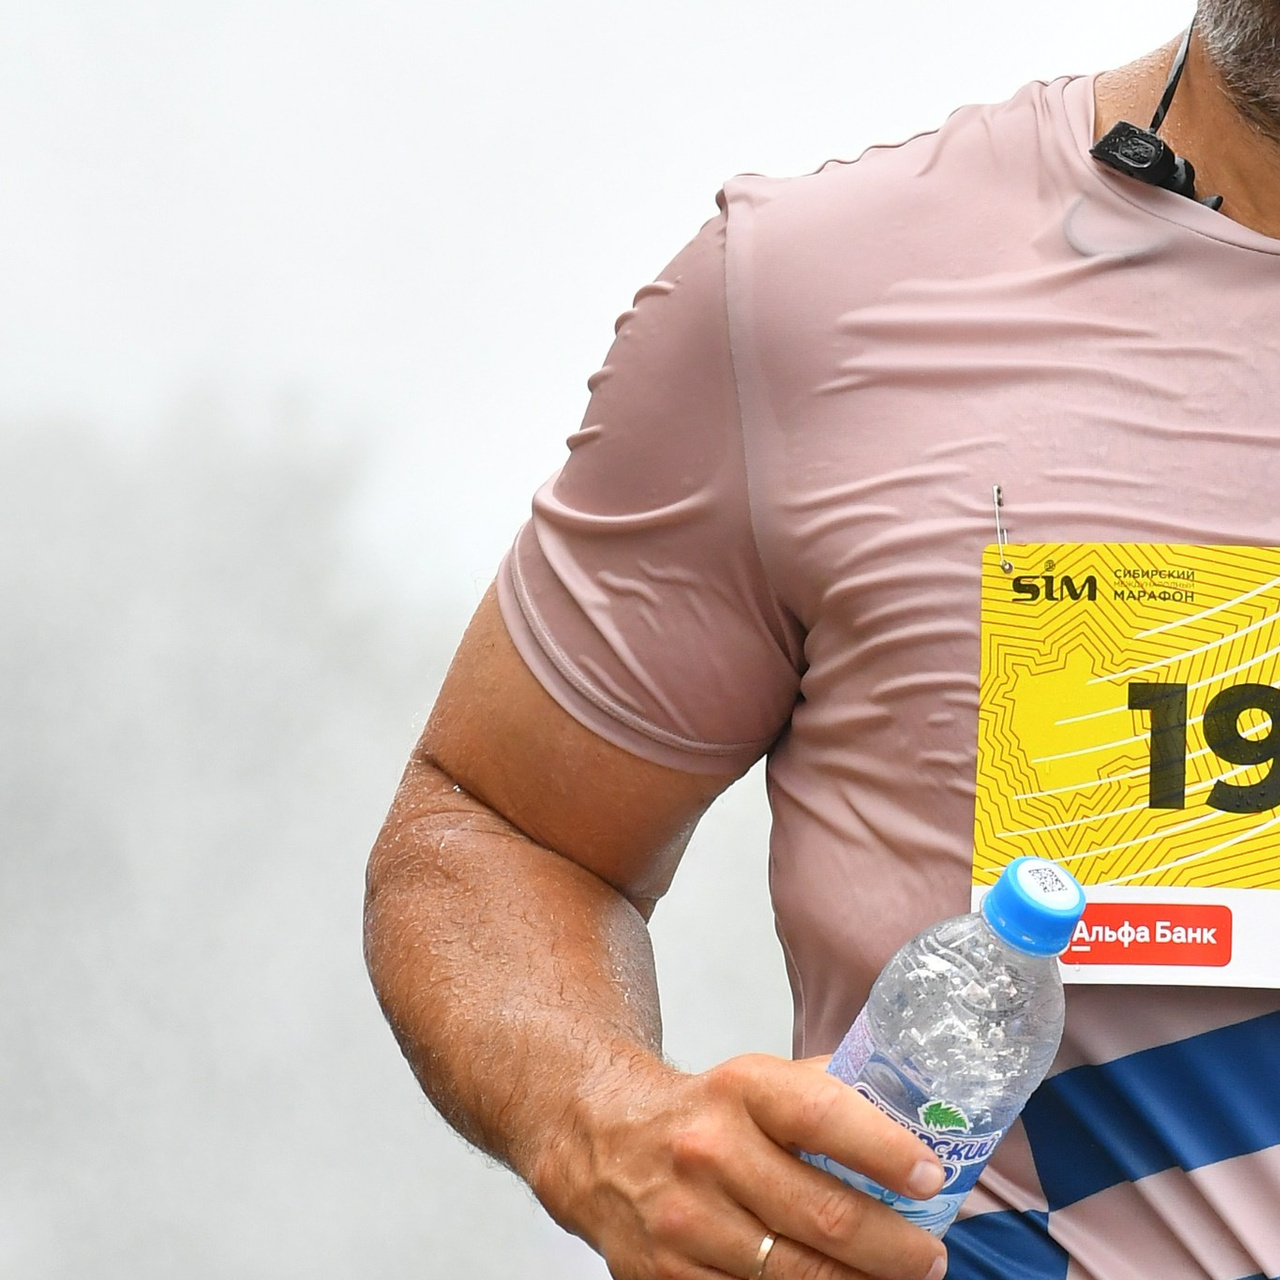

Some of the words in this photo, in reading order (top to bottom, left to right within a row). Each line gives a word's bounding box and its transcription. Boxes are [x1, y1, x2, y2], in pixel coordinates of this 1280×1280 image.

[1113, 569, 1195, 581] СИБИРСКИЙ
[1113, 590, 1195, 603] МАРАФОН
[1072, 920, 1150, 948] Альфа
[1155, 920, 1217, 945] Банк
